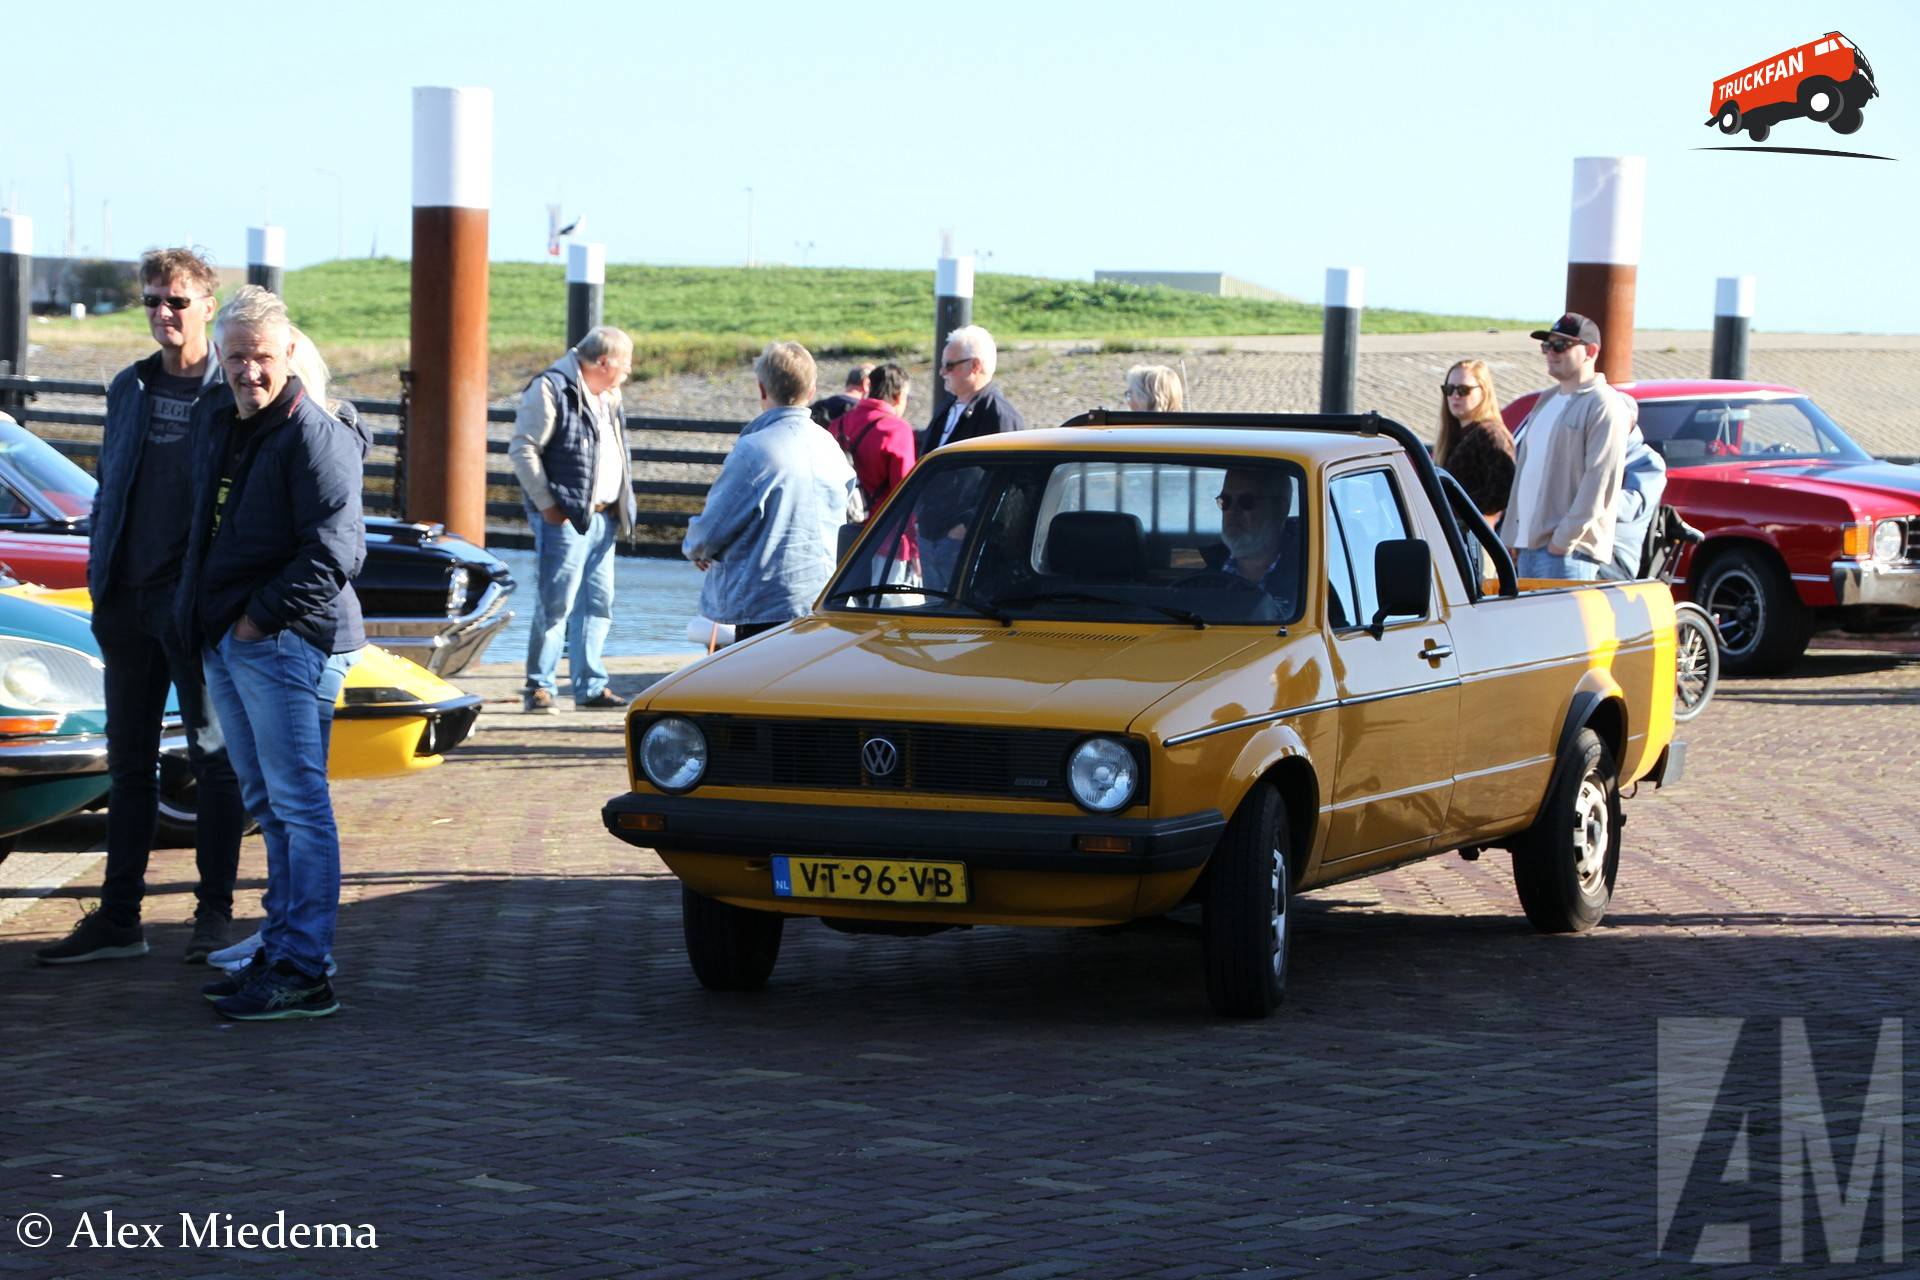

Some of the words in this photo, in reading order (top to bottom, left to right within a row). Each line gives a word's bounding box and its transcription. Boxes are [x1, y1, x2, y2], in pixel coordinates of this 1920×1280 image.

[862, 738, 897, 776] VW
[775, 879, 790, 890] NL
[799, 862, 954, 897] VT-96-VB
